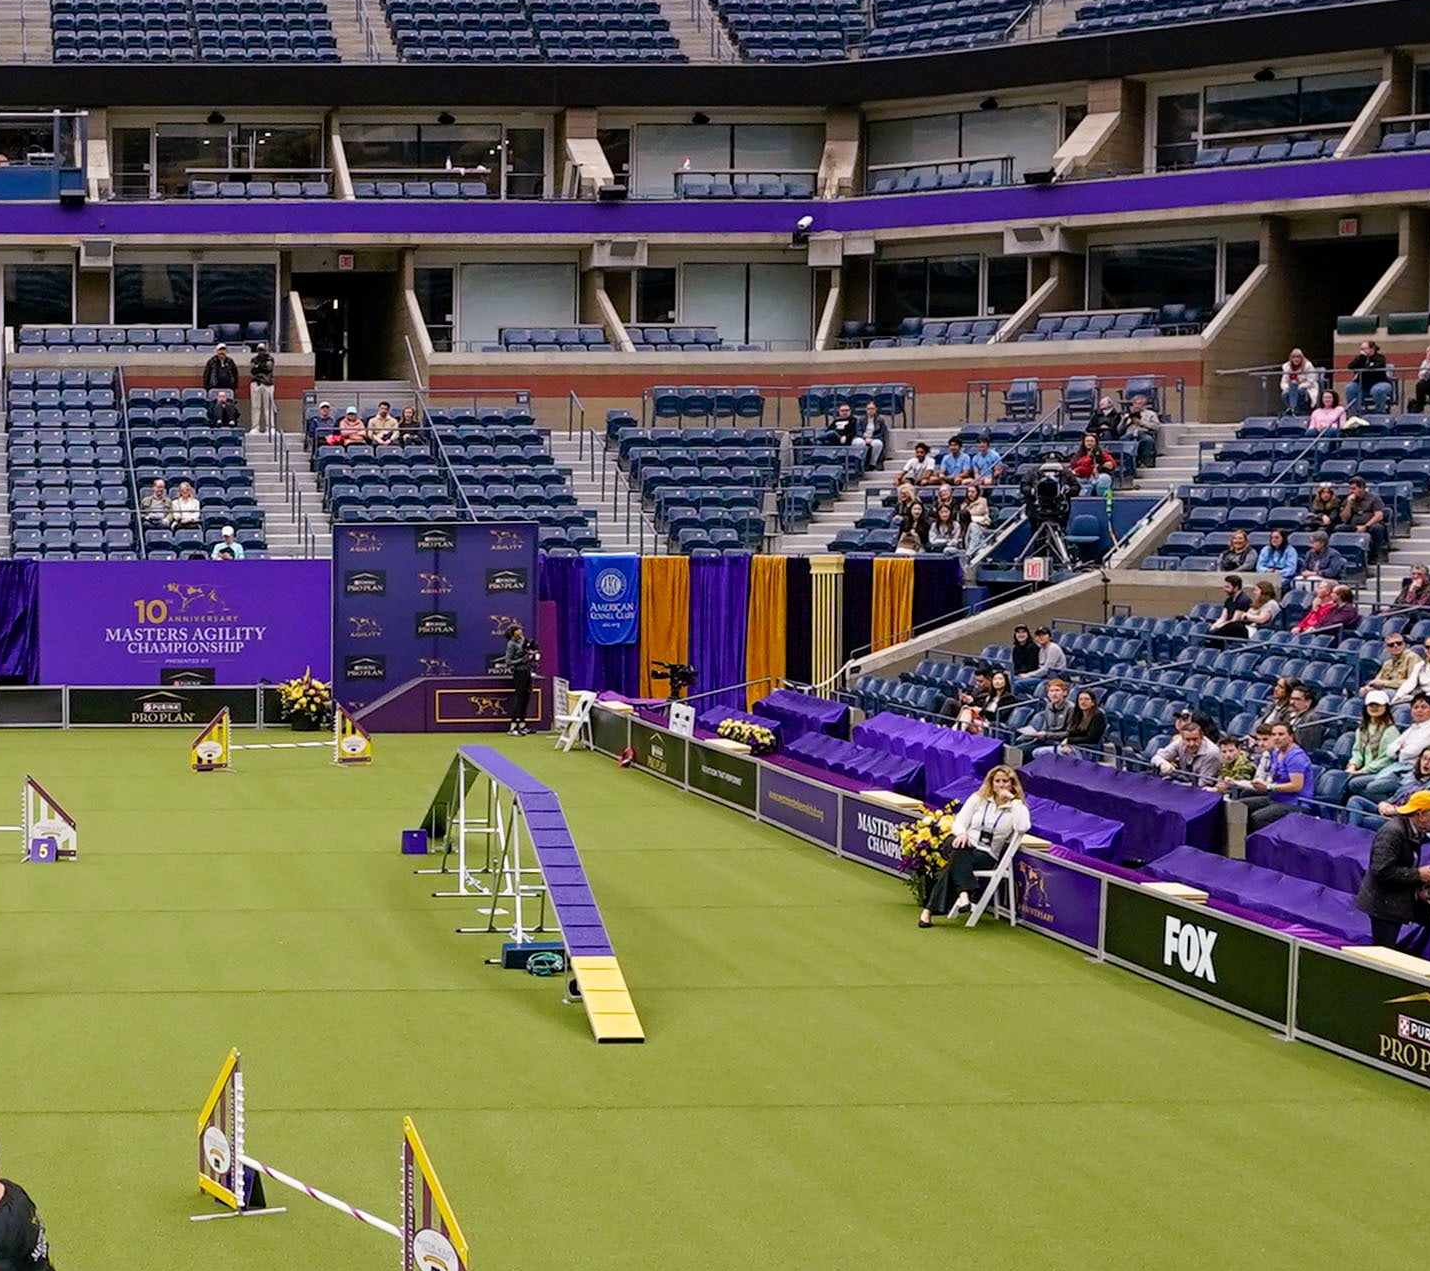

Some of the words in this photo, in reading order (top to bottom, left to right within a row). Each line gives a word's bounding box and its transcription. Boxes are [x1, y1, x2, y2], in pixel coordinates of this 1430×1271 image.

[1027, 562, 1042, 578] EXIT
[105, 627, 188, 642] MASTERS
[192, 626, 267, 642] AGILITY
[127, 641, 245, 654] CHAMPIONSHIP
[131, 712, 159, 723] PRO
[38, 843, 49, 858] 5
[1163, 915, 1218, 983] FOX
[1379, 1034, 1419, 1069] PRO
